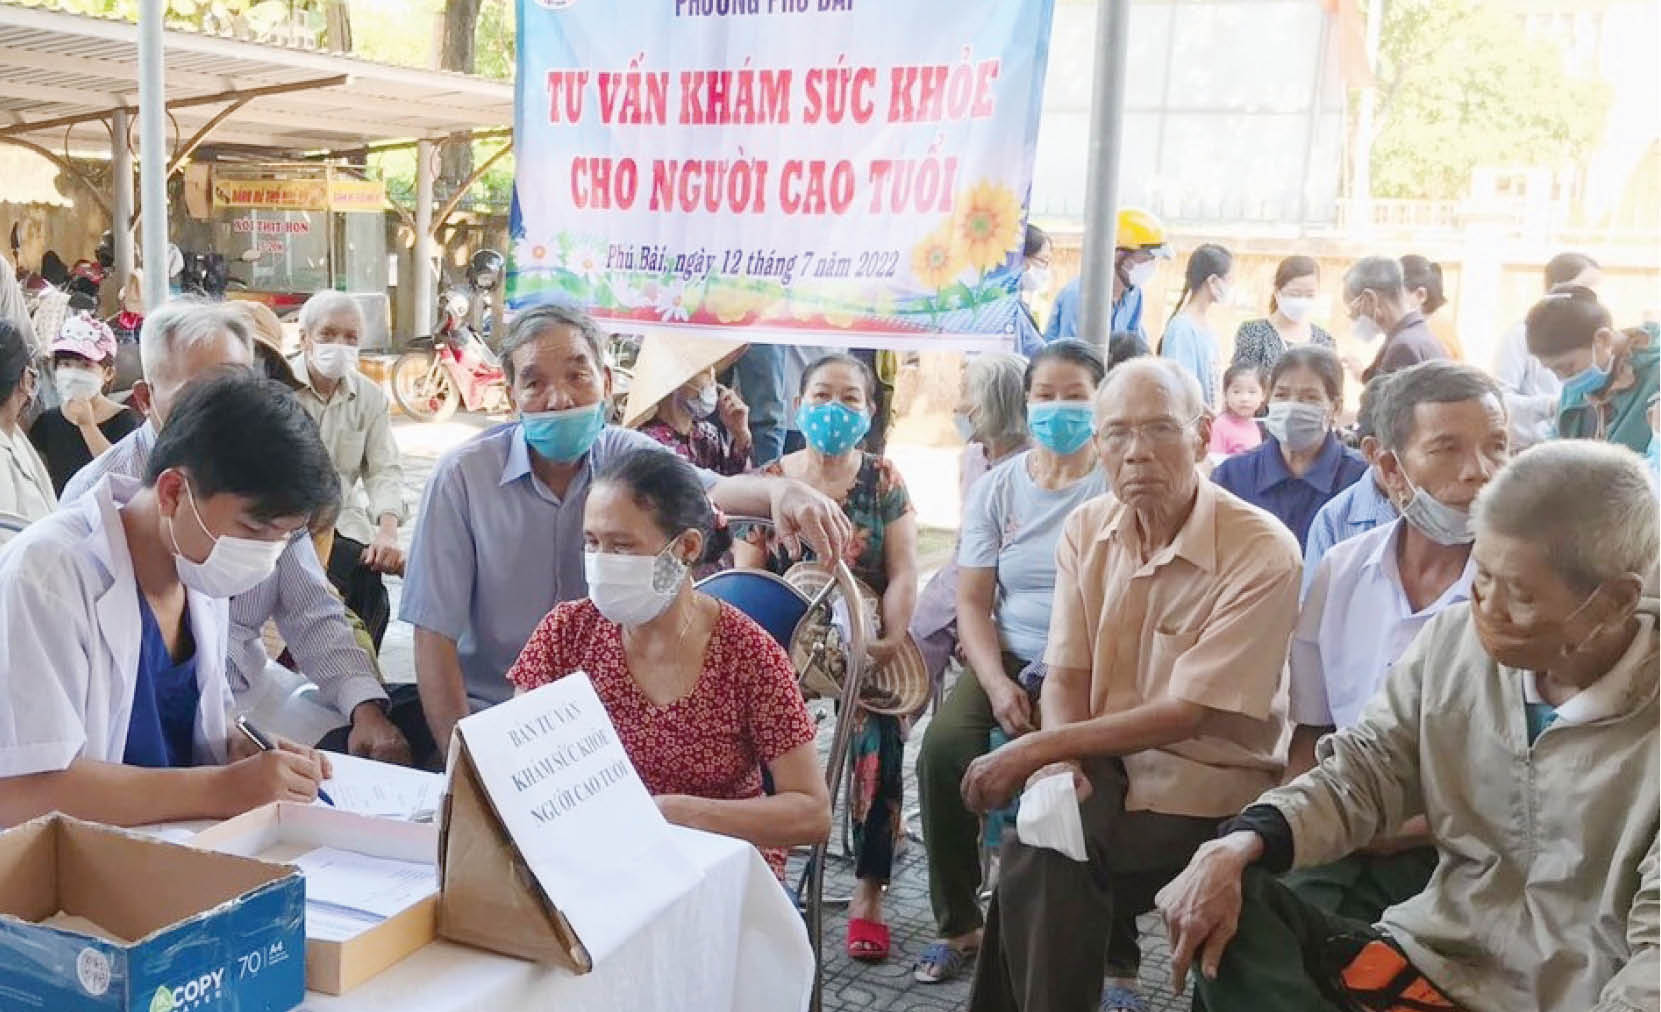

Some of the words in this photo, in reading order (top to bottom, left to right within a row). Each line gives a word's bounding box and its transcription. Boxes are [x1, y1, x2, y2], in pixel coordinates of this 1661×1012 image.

[547, 70, 589, 124] TƯ
[598, 52, 671, 124] VẤN
[678, 56, 793, 124] KHÁM
[802, 54, 876, 125] SỨC
[886, 46, 1000, 123] KHỎE
[570, 156, 638, 210] CHO
[648, 146, 768, 213] NGƯỜI
[779, 159, 855, 214] CAO
[868, 135, 958, 215] TUỔI
[606, 244, 633, 269] Phú
[674, 248, 716, 281] ngày
[721, 250, 742, 275] 12
[746, 249, 798, 285] tháng
[800, 252, 814, 277] 7
[854, 251, 899, 279] 2022
[238, 951, 261, 979] 70
[171, 967, 224, 1008] COPY
